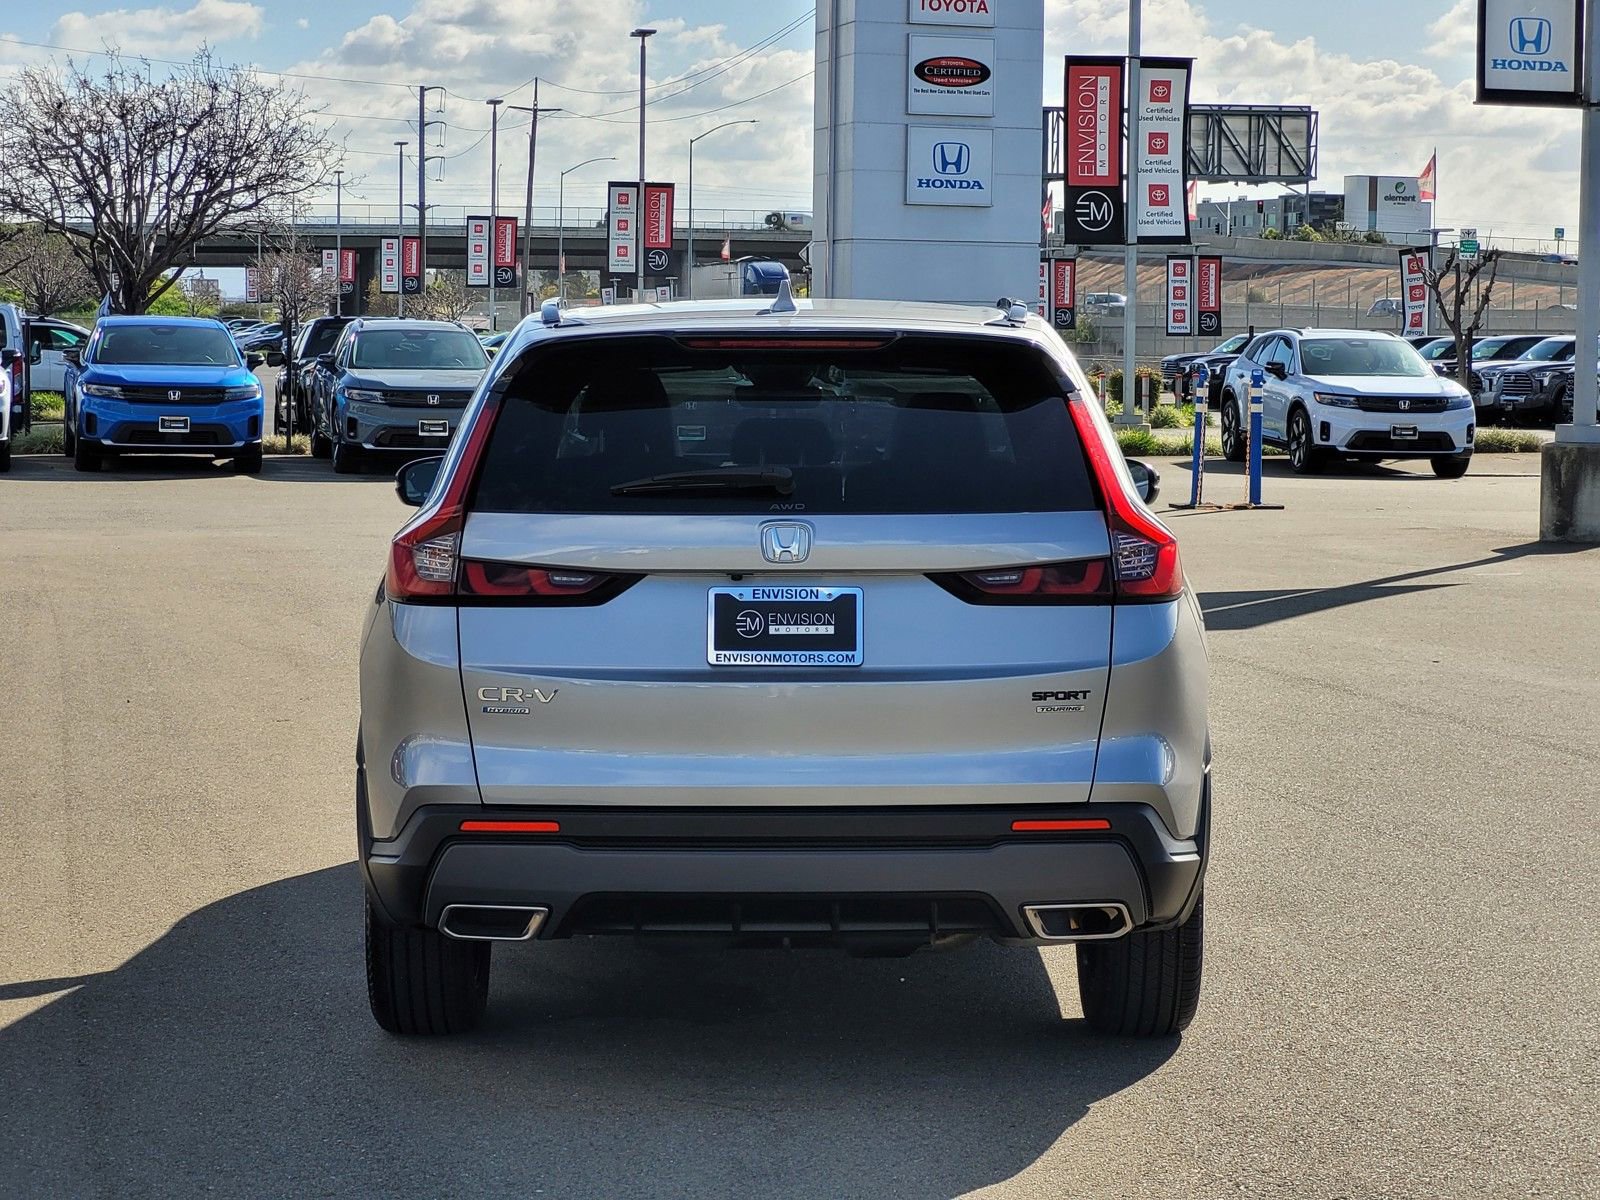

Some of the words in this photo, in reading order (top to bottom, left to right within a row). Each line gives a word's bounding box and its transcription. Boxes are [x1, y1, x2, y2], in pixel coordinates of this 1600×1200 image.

[919, 0, 988, 14] TOYOTA
[1491, 58, 1568, 72] HONDA
[1078, 76, 1096, 176] ENVISION
[1099, 85, 1108, 168] MOTORS
[917, 178, 984, 190] HONDA
[1384, 194, 1416, 202] element
[650, 192, 660, 243] ENVISION
[498, 224, 507, 263] ENVISION
[752, 589, 819, 600] ENVISION
[769, 613, 835, 625] ENVISION
[715, 654, 855, 663] ENVISIONMOTORS.COM
[478, 687, 558, 703] CR-V
[1032, 690, 1091, 701] SPORT
